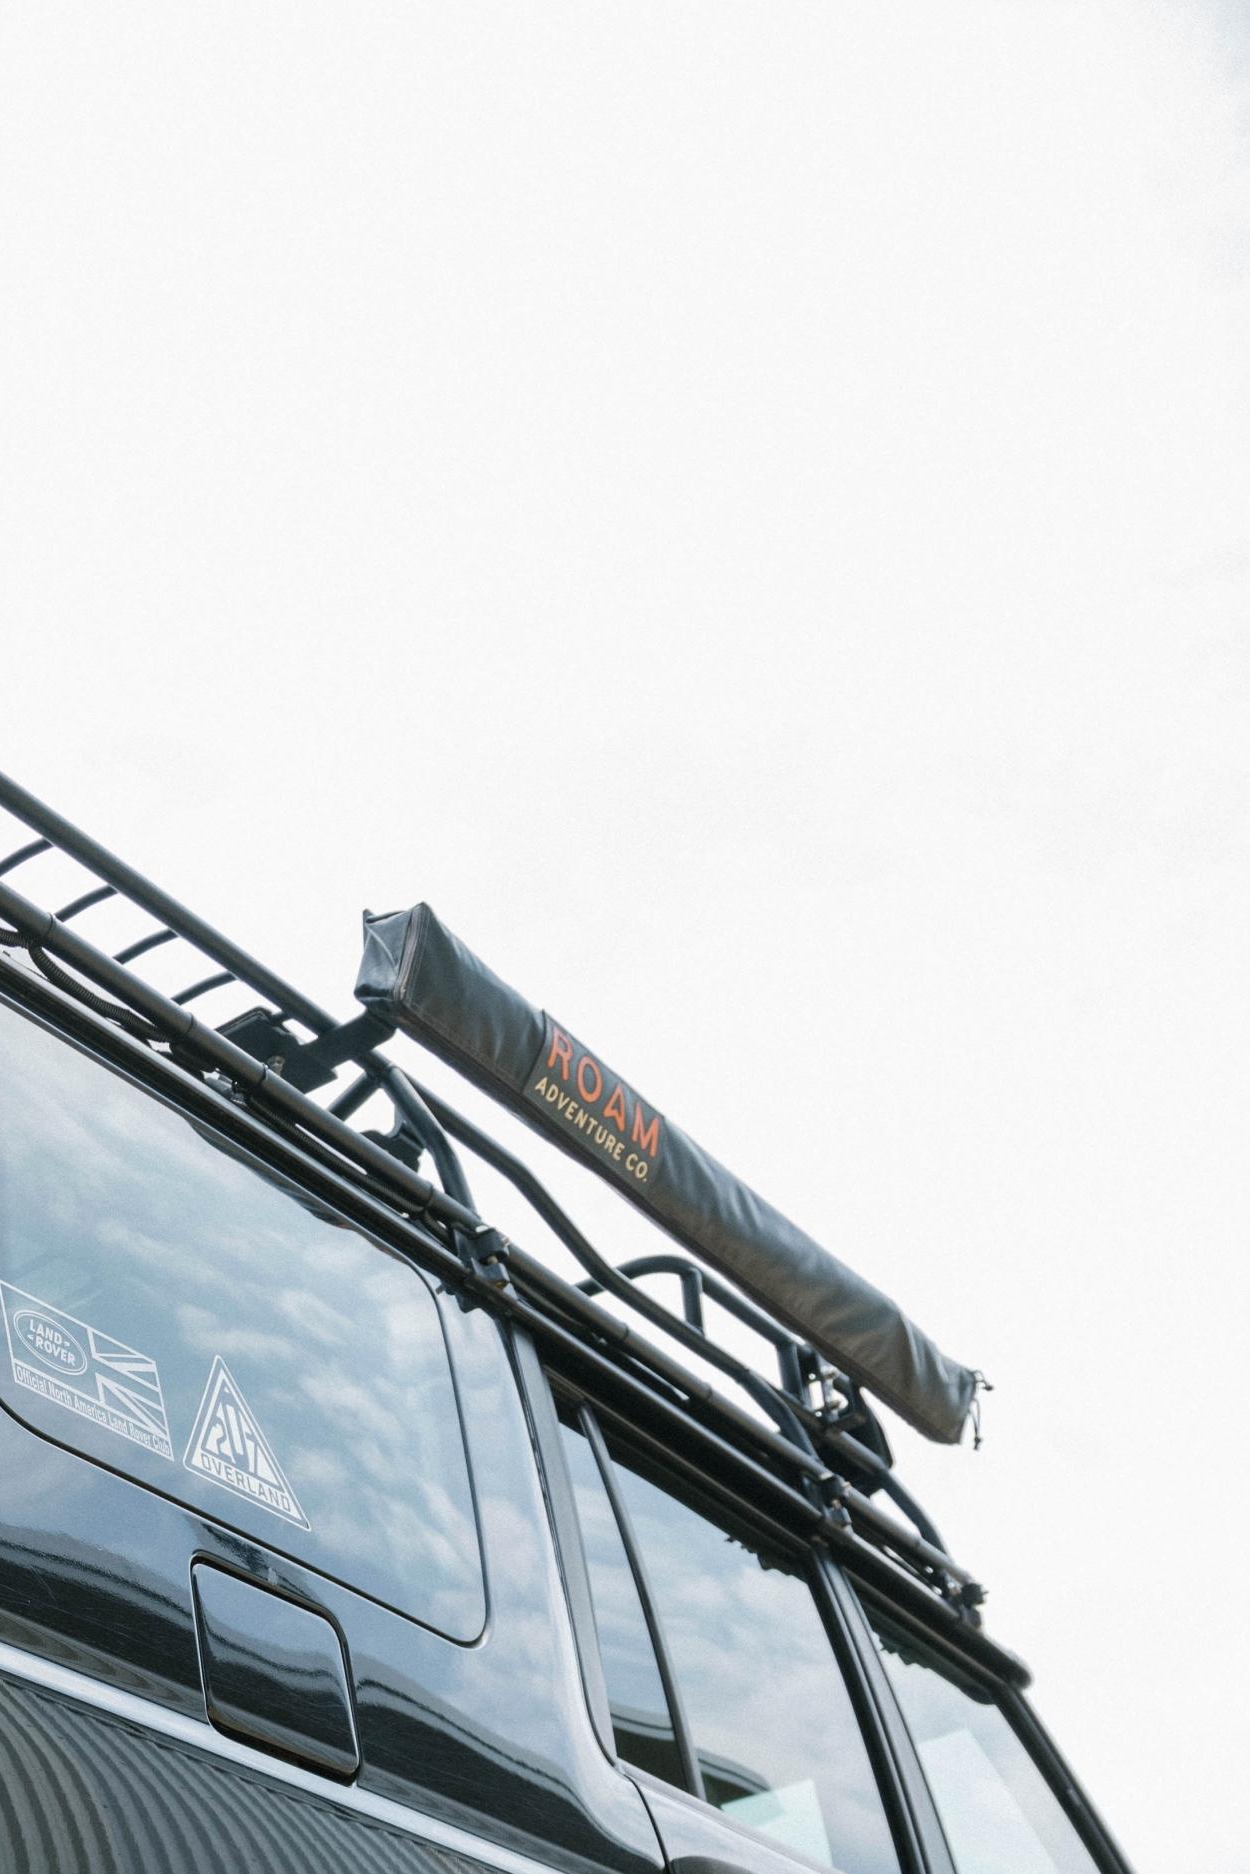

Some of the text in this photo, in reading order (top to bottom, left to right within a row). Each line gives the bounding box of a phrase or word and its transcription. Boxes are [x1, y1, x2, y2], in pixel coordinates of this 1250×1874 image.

[547, 1028, 660, 1158] ROAM
[535, 1076, 649, 1182] ADVENTURE CO.
[30, 1319, 62, 1345] LAND
[36, 1335, 75, 1367] ROVER
[16, 1366, 47, 1393] Official
[48, 1382, 73, 1407] North
[108, 1411, 128, 1435] Land
[200, 1453, 292, 1513] OVERLAND
